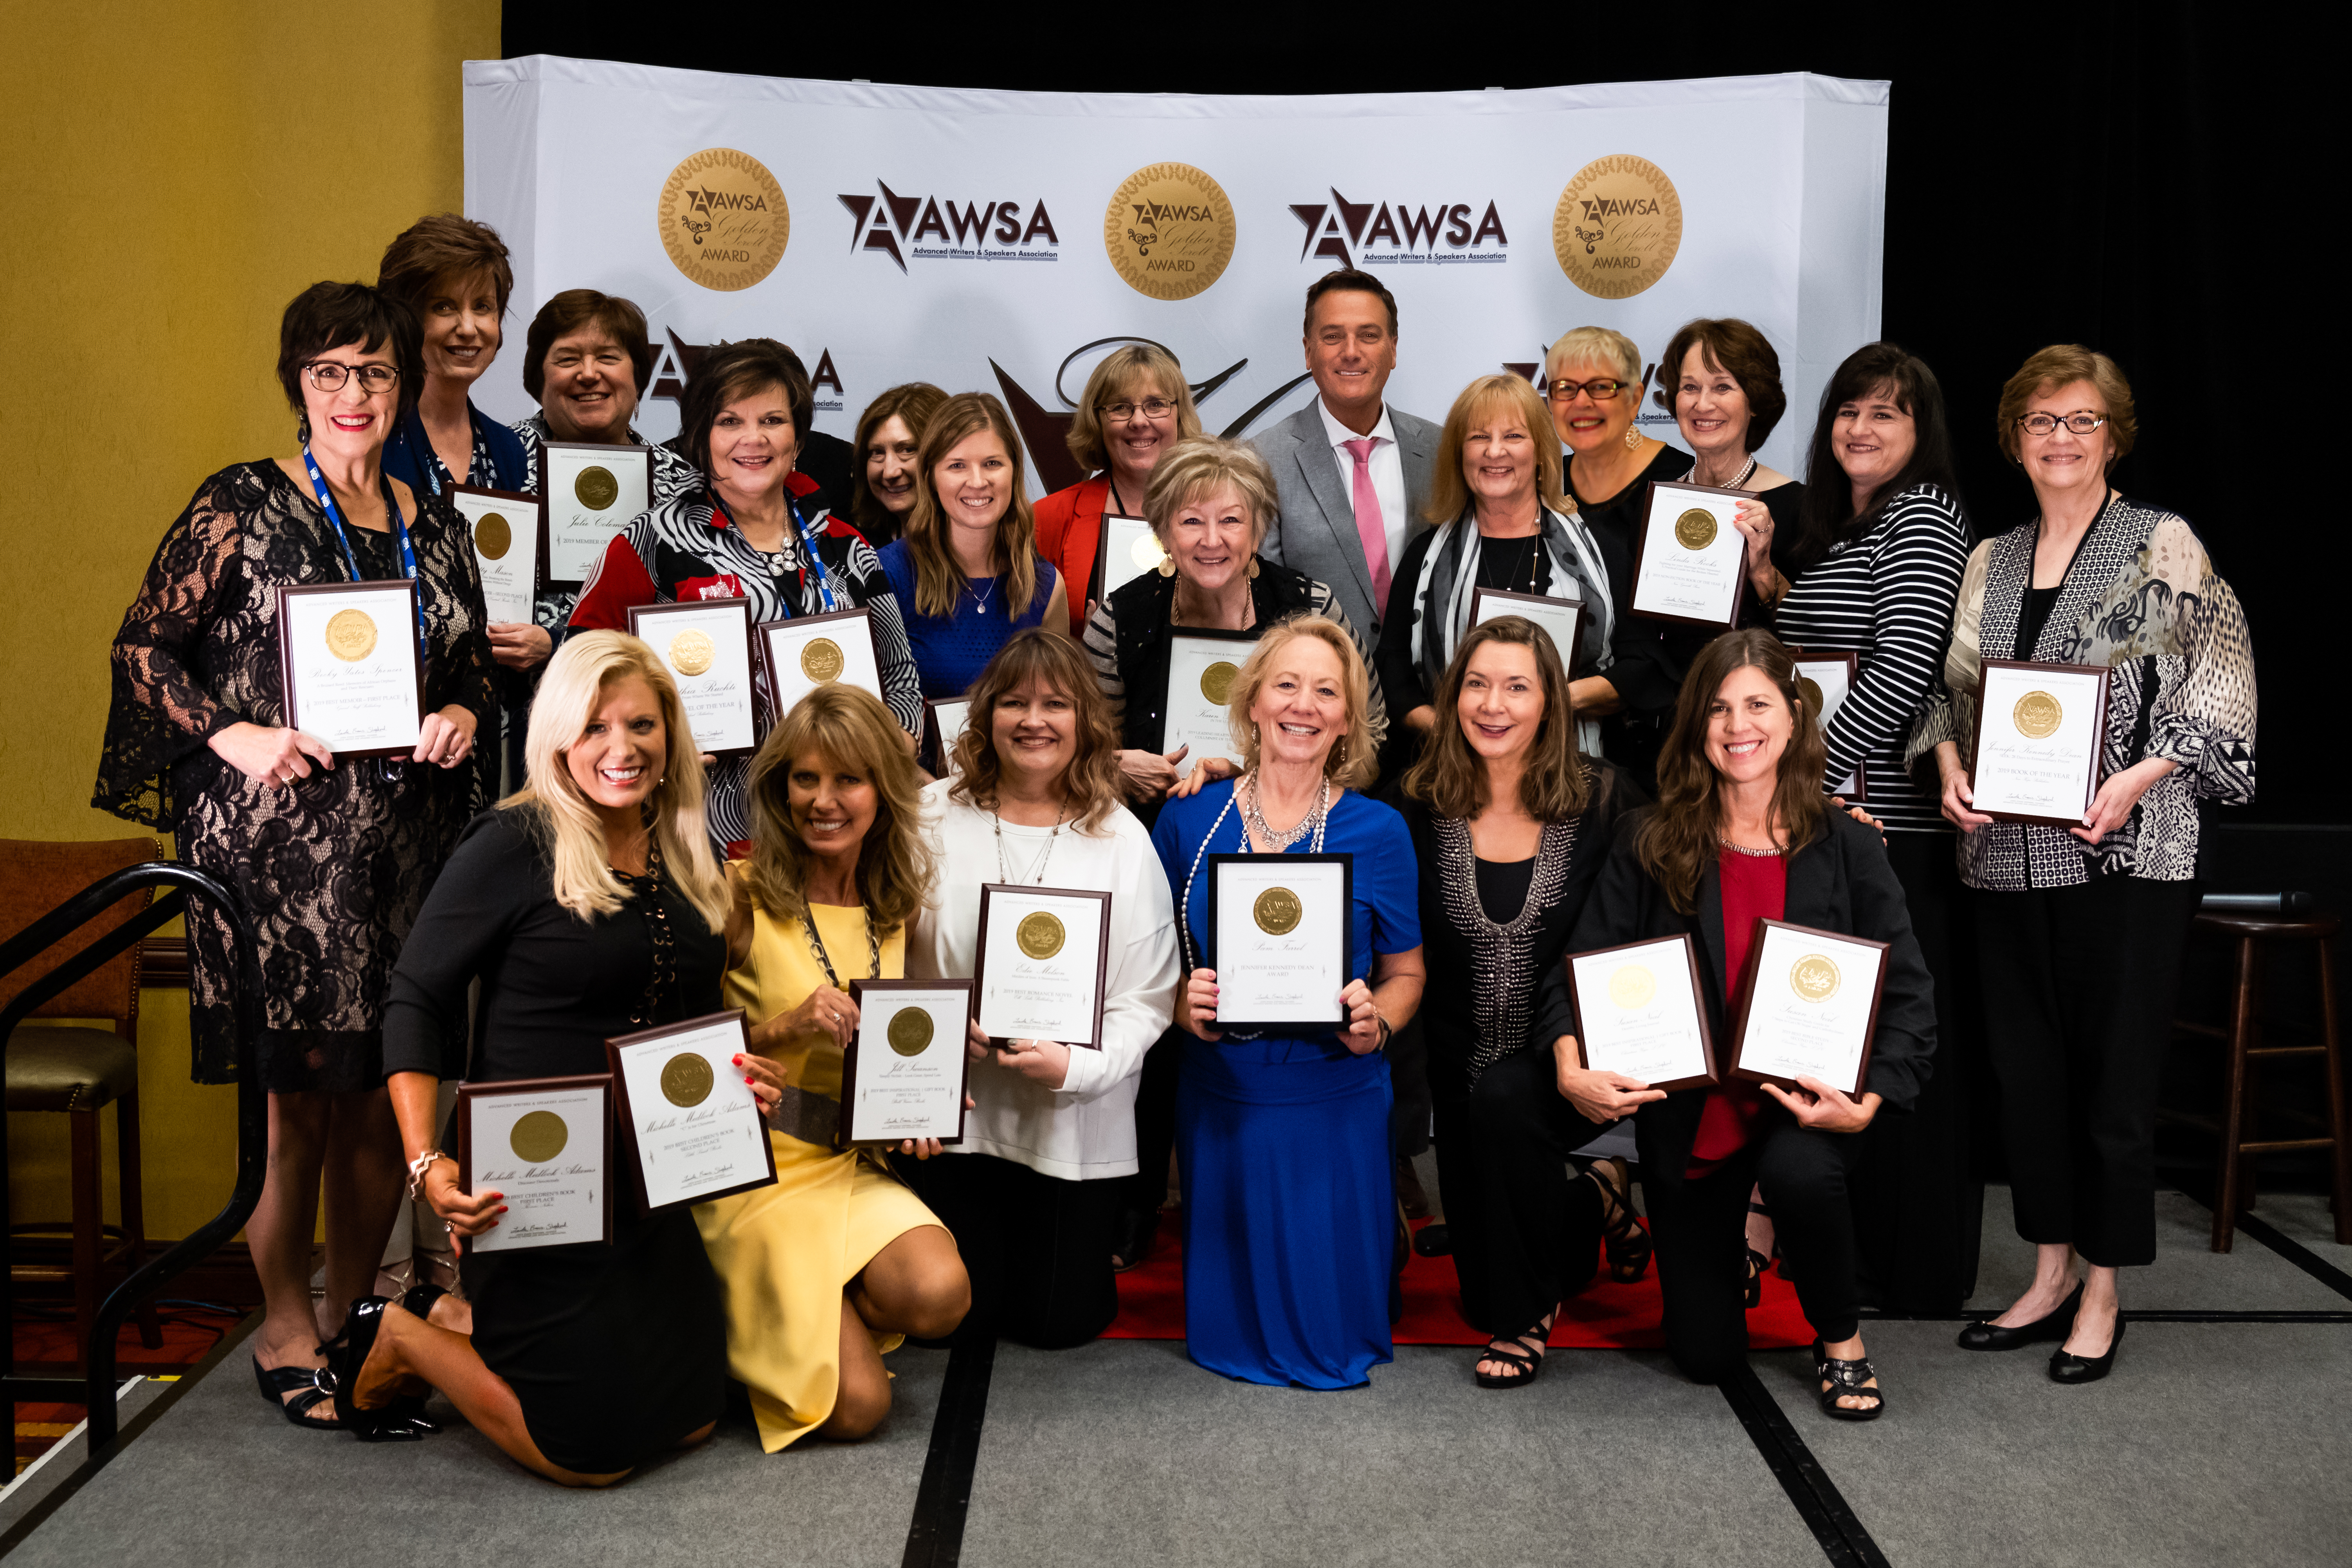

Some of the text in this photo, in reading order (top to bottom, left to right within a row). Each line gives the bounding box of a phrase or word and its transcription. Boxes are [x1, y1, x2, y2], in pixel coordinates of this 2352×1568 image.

[913, 194, 1059, 249] AWSA
[1363, 199, 1508, 253] AWSA
[701, 248, 750, 262] AWARD
[984, 249, 1016, 258] Speakers
[1434, 253, 1466, 261] Speakers
[1146, 259, 1195, 272] AWARD
[1592, 256, 1641, 269] AWARD
[566, 514, 589, 529] Julie
[1664, 552, 1689, 563] Linda
[490, 564, 513, 576] Mason
[308, 663, 402, 679] Becky Yates Spencer
[679, 680, 735, 695] thia Ruchti
[1195, 709, 1218, 718] Karen
[1984, 740, 2082, 758] Jennifer Kennedy Dean
[1252, 940, 1307, 951] Pam Farrel
[1016, 962, 1064, 975] Edie Melson
[1613, 1010, 1664, 1026] Susan Neal
[1779, 1003, 1840, 1022] Susan Neal
[888, 1061, 938, 1074] Jill Swanson
[640, 1100, 751, 1134] Michelle Medlock Adams
[680, 1142, 702, 1152] SECOND
[702, 1138, 720, 1147] PLACE
